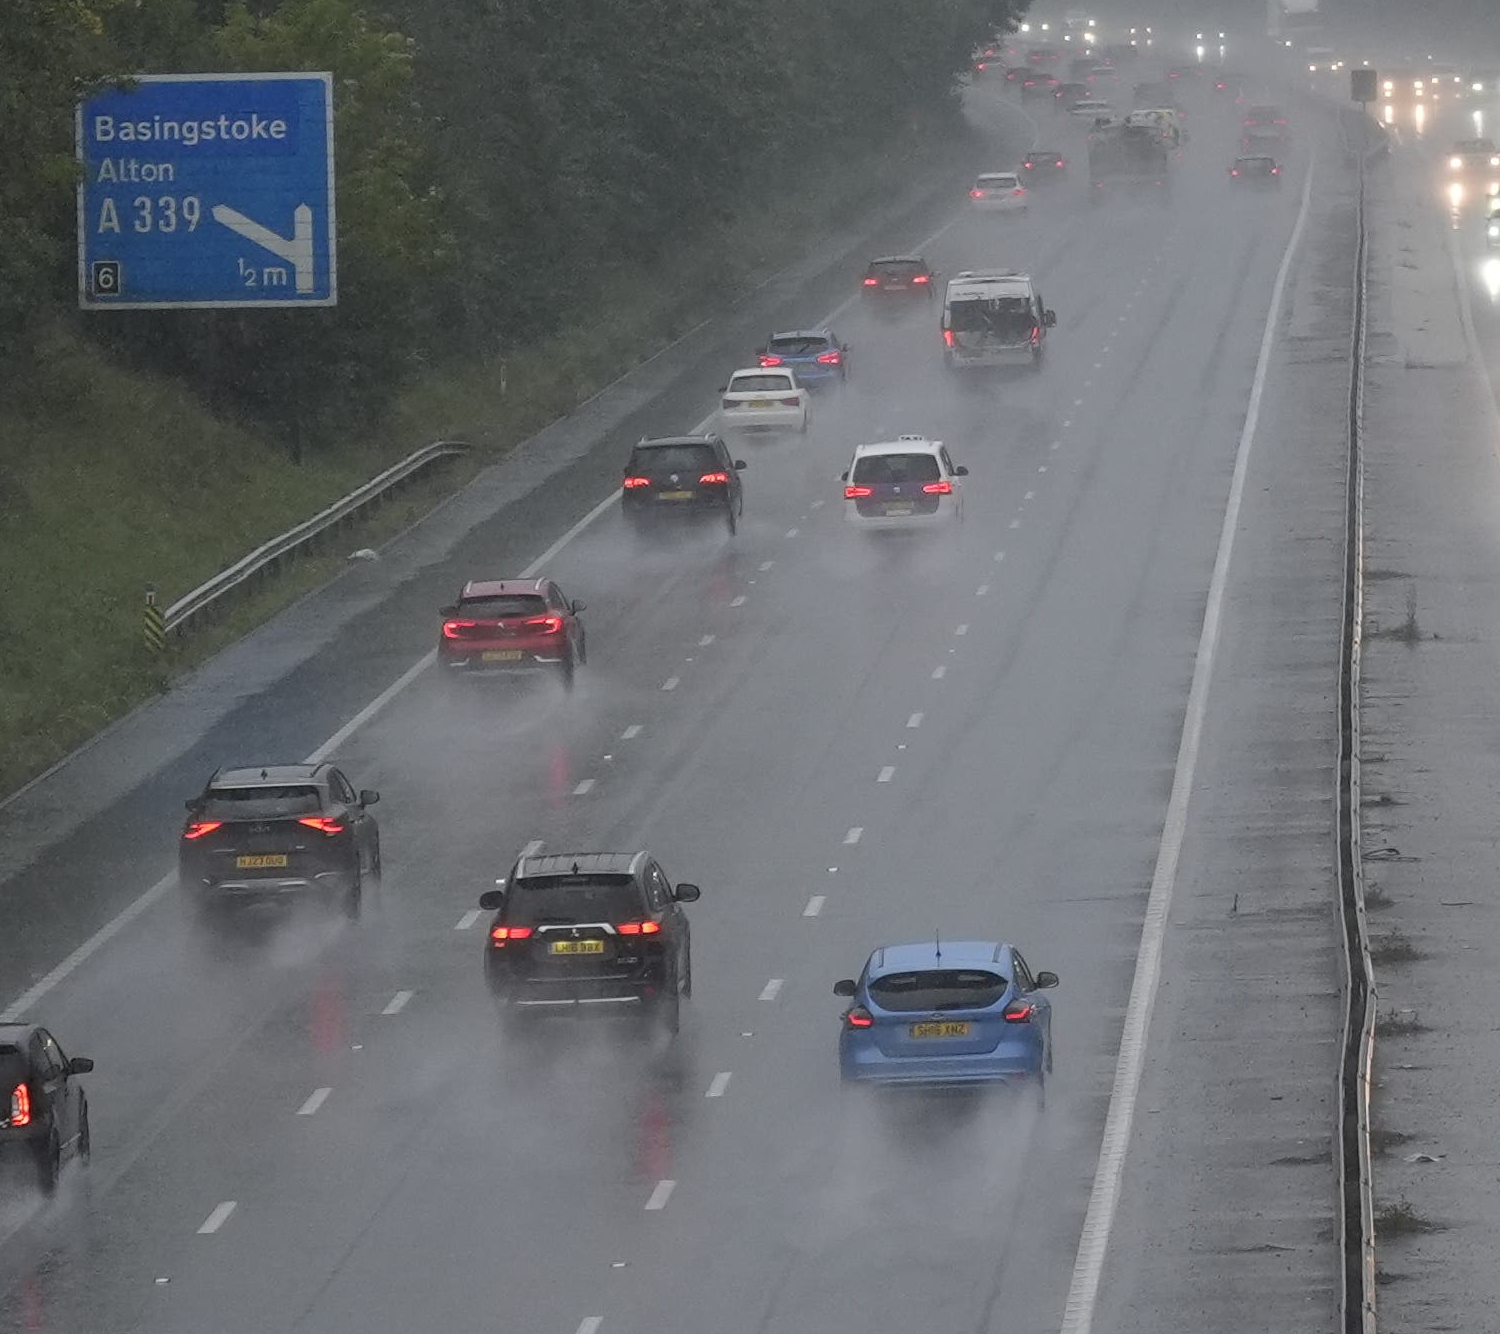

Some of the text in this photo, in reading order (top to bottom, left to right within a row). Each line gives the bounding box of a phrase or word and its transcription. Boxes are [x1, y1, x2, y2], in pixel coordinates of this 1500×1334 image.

[95, 114, 287, 145] Basingstoke
[97, 157, 174, 183] Alton
[99, 268, 114, 289] 6
